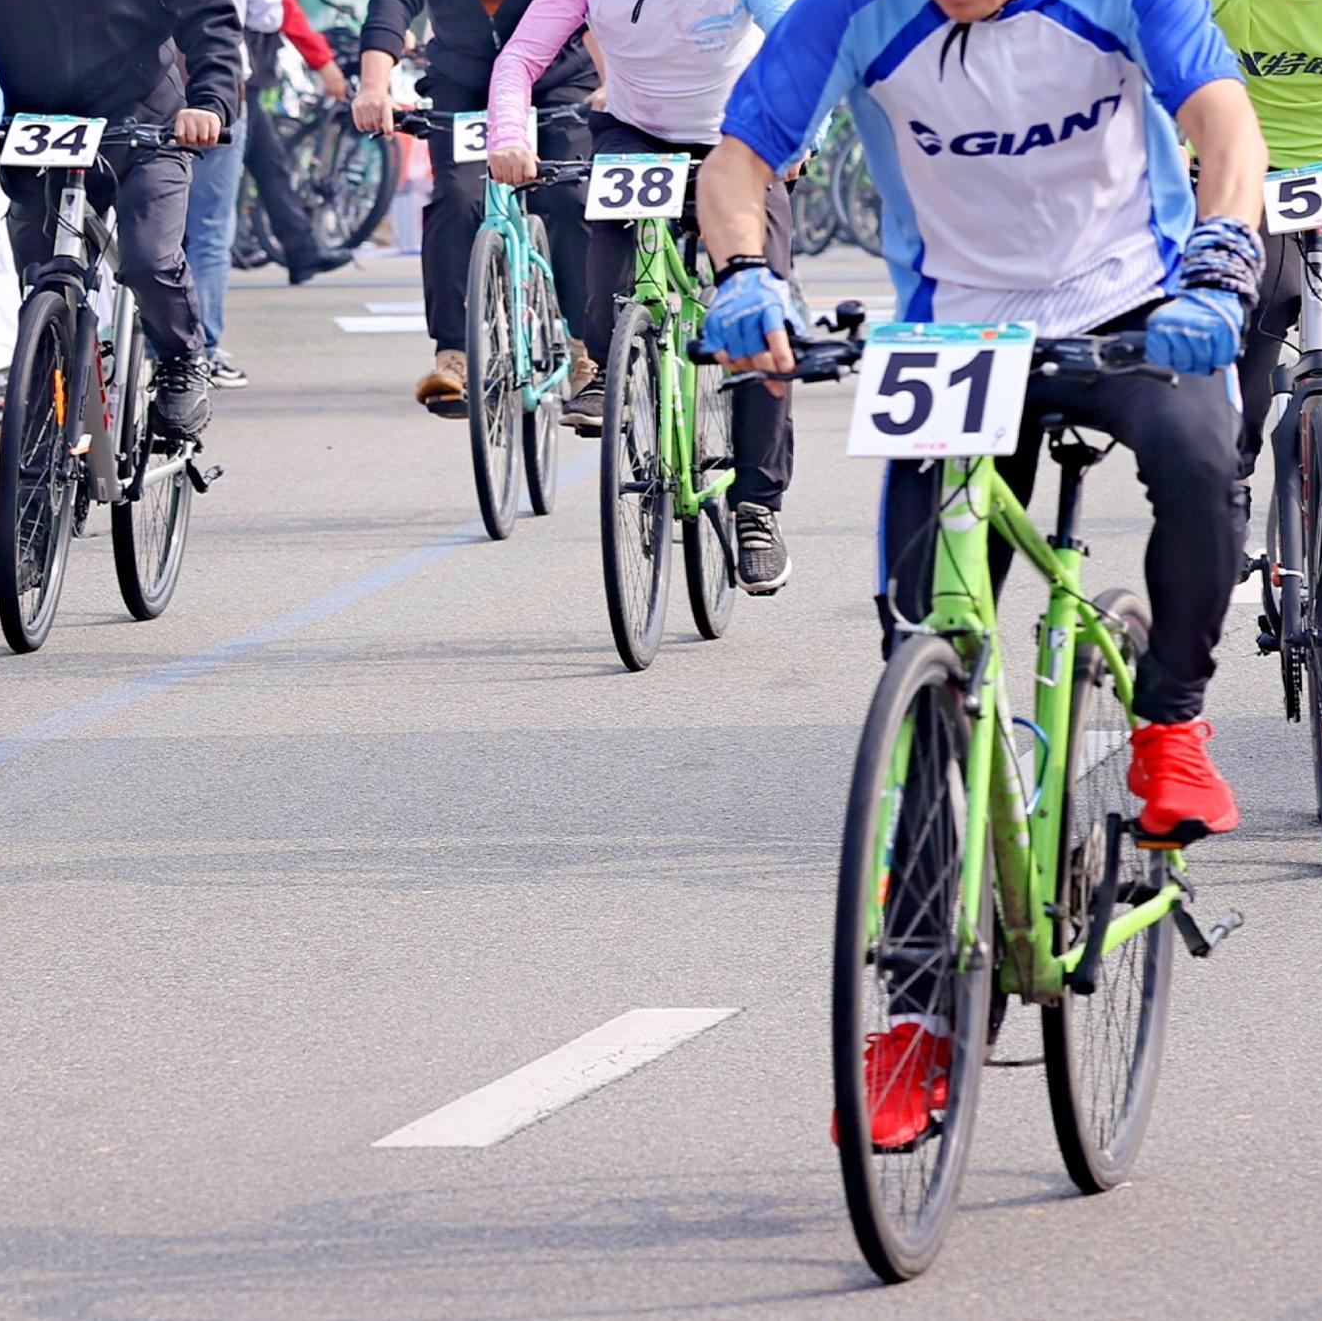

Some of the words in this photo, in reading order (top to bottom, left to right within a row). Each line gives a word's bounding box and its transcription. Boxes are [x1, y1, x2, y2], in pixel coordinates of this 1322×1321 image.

[14, 124, 88, 157] 34
[948, 78, 1126, 157] GIANT
[598, 166, 674, 209] 38
[871, 349, 996, 436] 51
